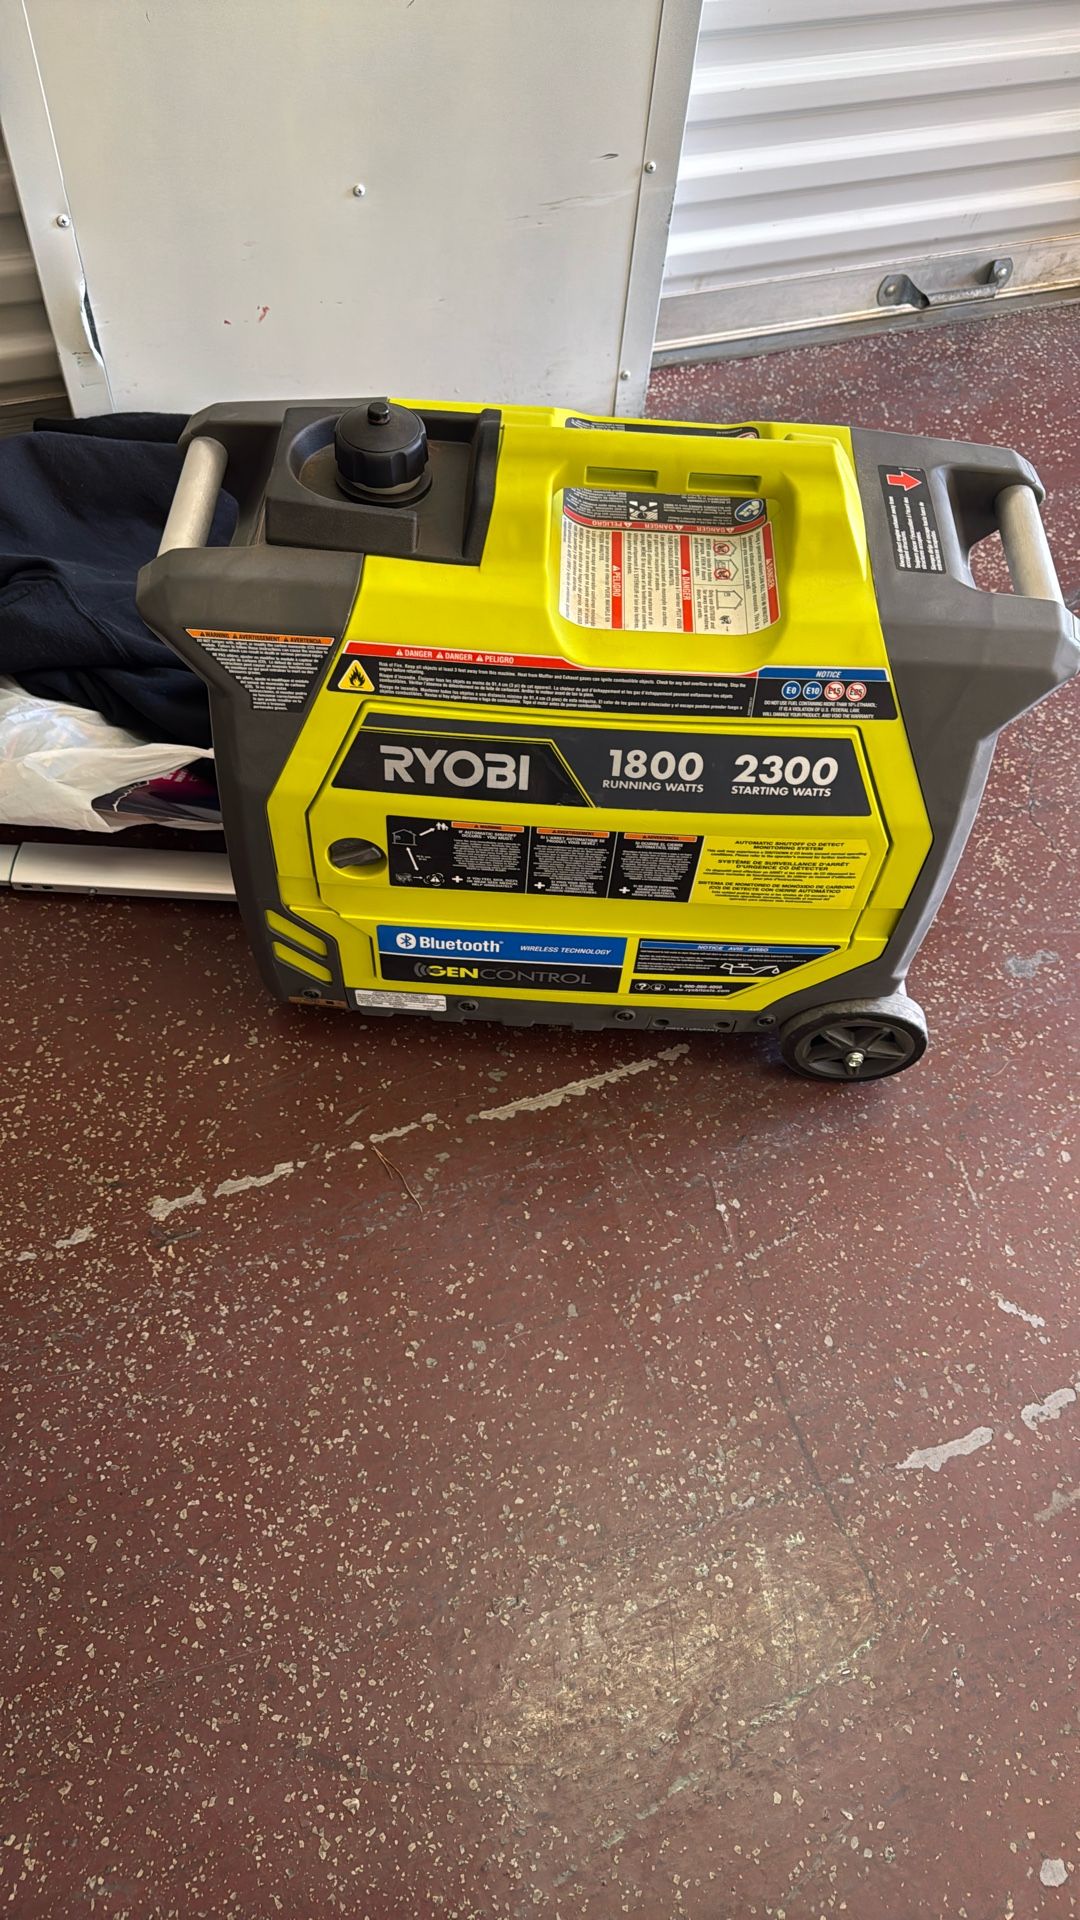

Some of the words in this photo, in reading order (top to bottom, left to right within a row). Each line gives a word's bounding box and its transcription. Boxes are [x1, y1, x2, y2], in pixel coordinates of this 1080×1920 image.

[766, 566, 775, 590] DANGER
[405, 650, 432, 658] DANGER
[445, 652, 472, 661] DANGER
[484, 655, 514, 664] PELIGRO
[786, 686, 797, 694] E0
[806, 687, 819, 695] E10
[380, 745, 530, 790] RYOBI
[609, 750, 704, 781] 1800
[732, 754, 838, 784] 2300
[603, 780, 661, 792] RUNNING
[665, 782, 704, 793] WATTS
[731, 786, 789, 797] STARTING
[793, 787, 831, 797] WATTS
[520, 945, 558, 953] WIRELESS
[561, 947, 611, 956] TECHNOLOGY
